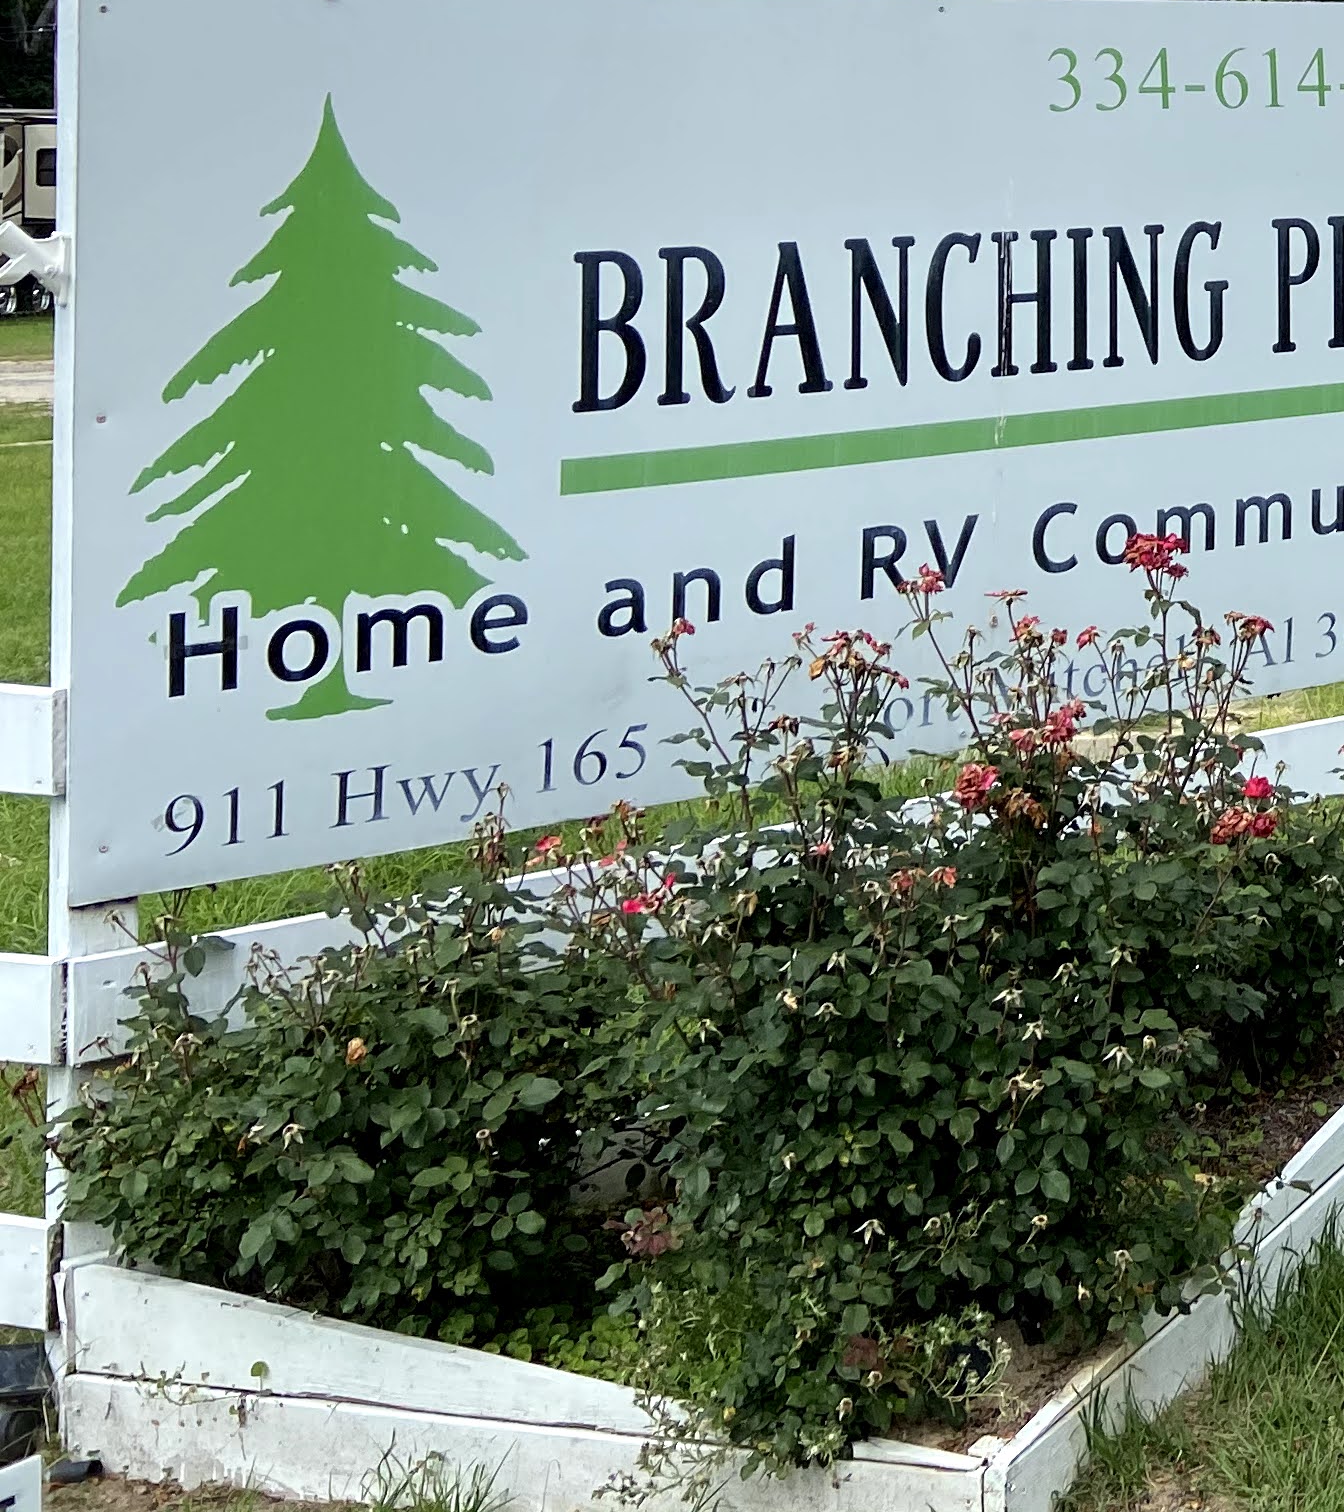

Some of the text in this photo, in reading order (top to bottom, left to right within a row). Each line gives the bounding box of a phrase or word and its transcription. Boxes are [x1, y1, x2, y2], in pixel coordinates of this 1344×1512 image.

[572, 220, 1229, 413] BRANCHING
[168, 593, 528, 698] Home
[597, 534, 796, 638] and
[860, 513, 979, 600] RV
[164, 779, 288, 857] 911
[328, 763, 501, 828] Hwy
[536, 722, 649, 793] 165
